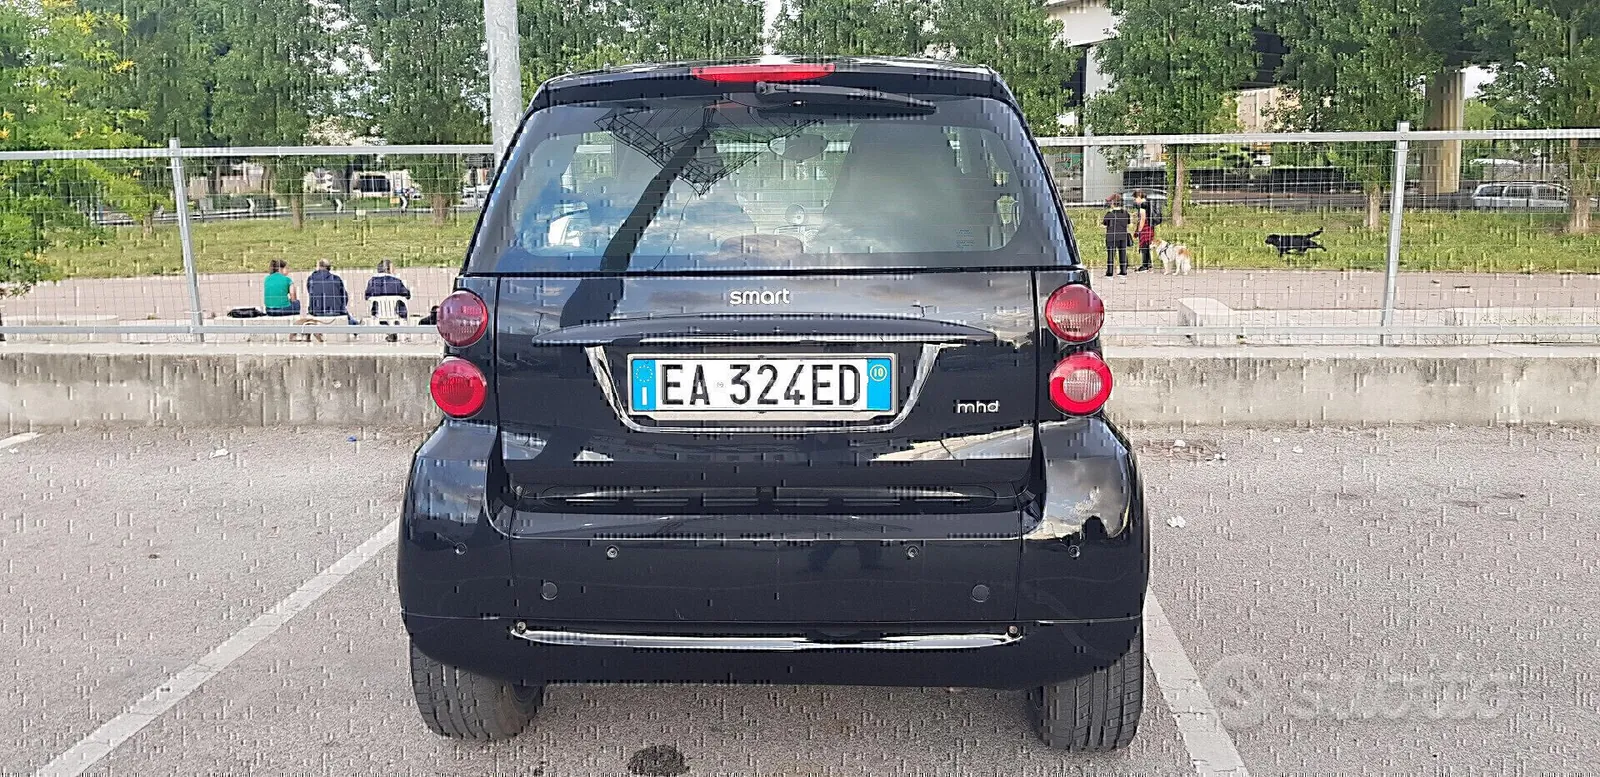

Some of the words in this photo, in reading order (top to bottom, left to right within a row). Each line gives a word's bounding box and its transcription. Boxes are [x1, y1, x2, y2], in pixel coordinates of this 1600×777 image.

[729, 288, 790, 305] smart
[661, 364, 711, 405] EA
[729, 364, 861, 406] 324ED
[956, 400, 999, 414] mhd
